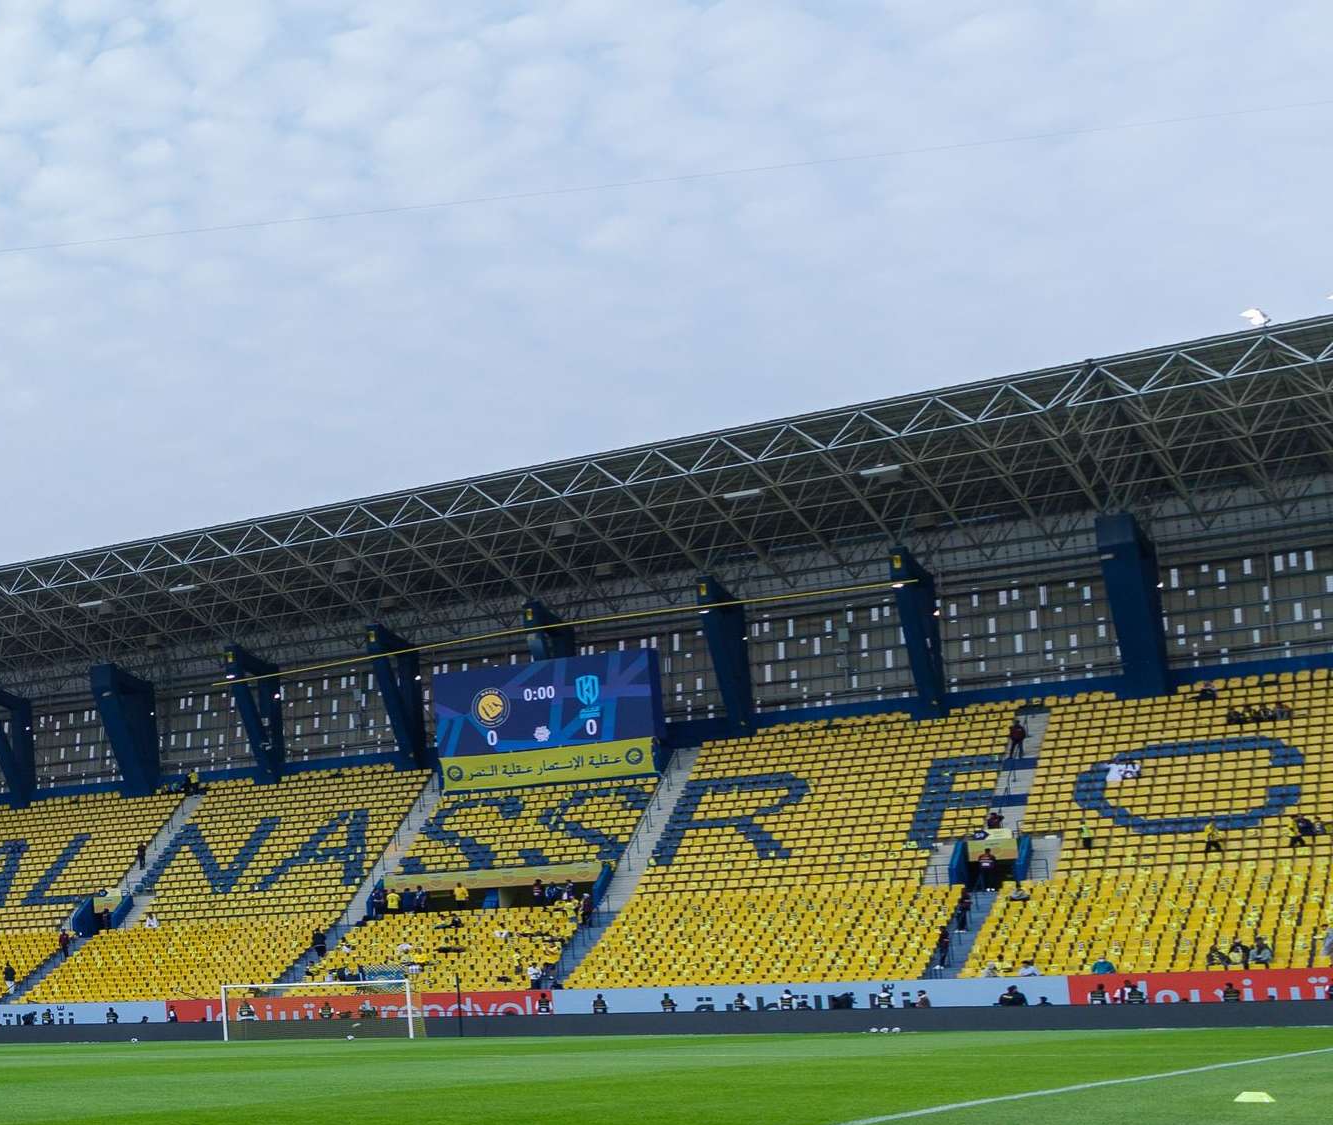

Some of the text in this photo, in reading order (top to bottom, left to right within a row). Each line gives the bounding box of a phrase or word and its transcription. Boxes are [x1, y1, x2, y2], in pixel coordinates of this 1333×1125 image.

[523, 685, 555, 701] 0:00
[586, 719, 597, 735] 0
[486, 730, 498, 746] 0
[134, 772, 807, 894] NASSR
[908, 735, 1305, 849] FC
